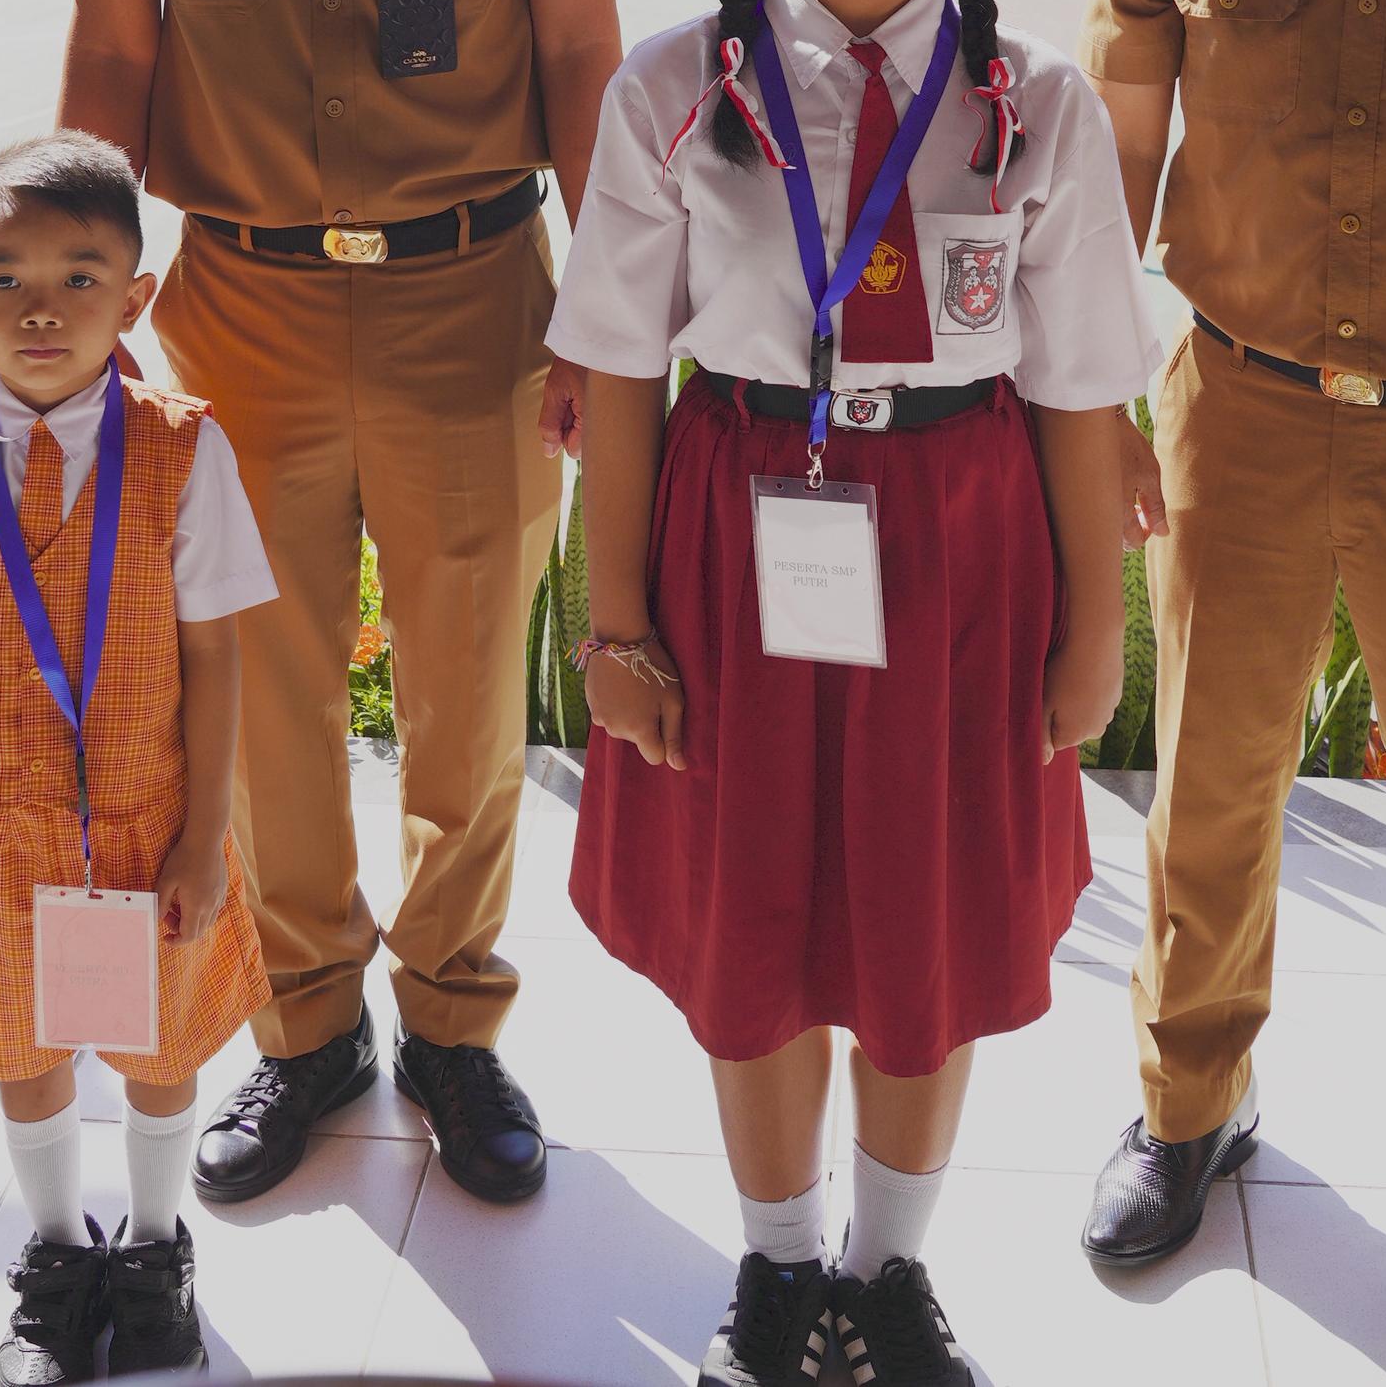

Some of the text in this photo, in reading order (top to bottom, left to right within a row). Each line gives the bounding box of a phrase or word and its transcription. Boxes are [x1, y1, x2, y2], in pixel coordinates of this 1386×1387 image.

[773, 560, 857, 577] PESERTA SMP
[792, 575, 829, 588] PUTRI
